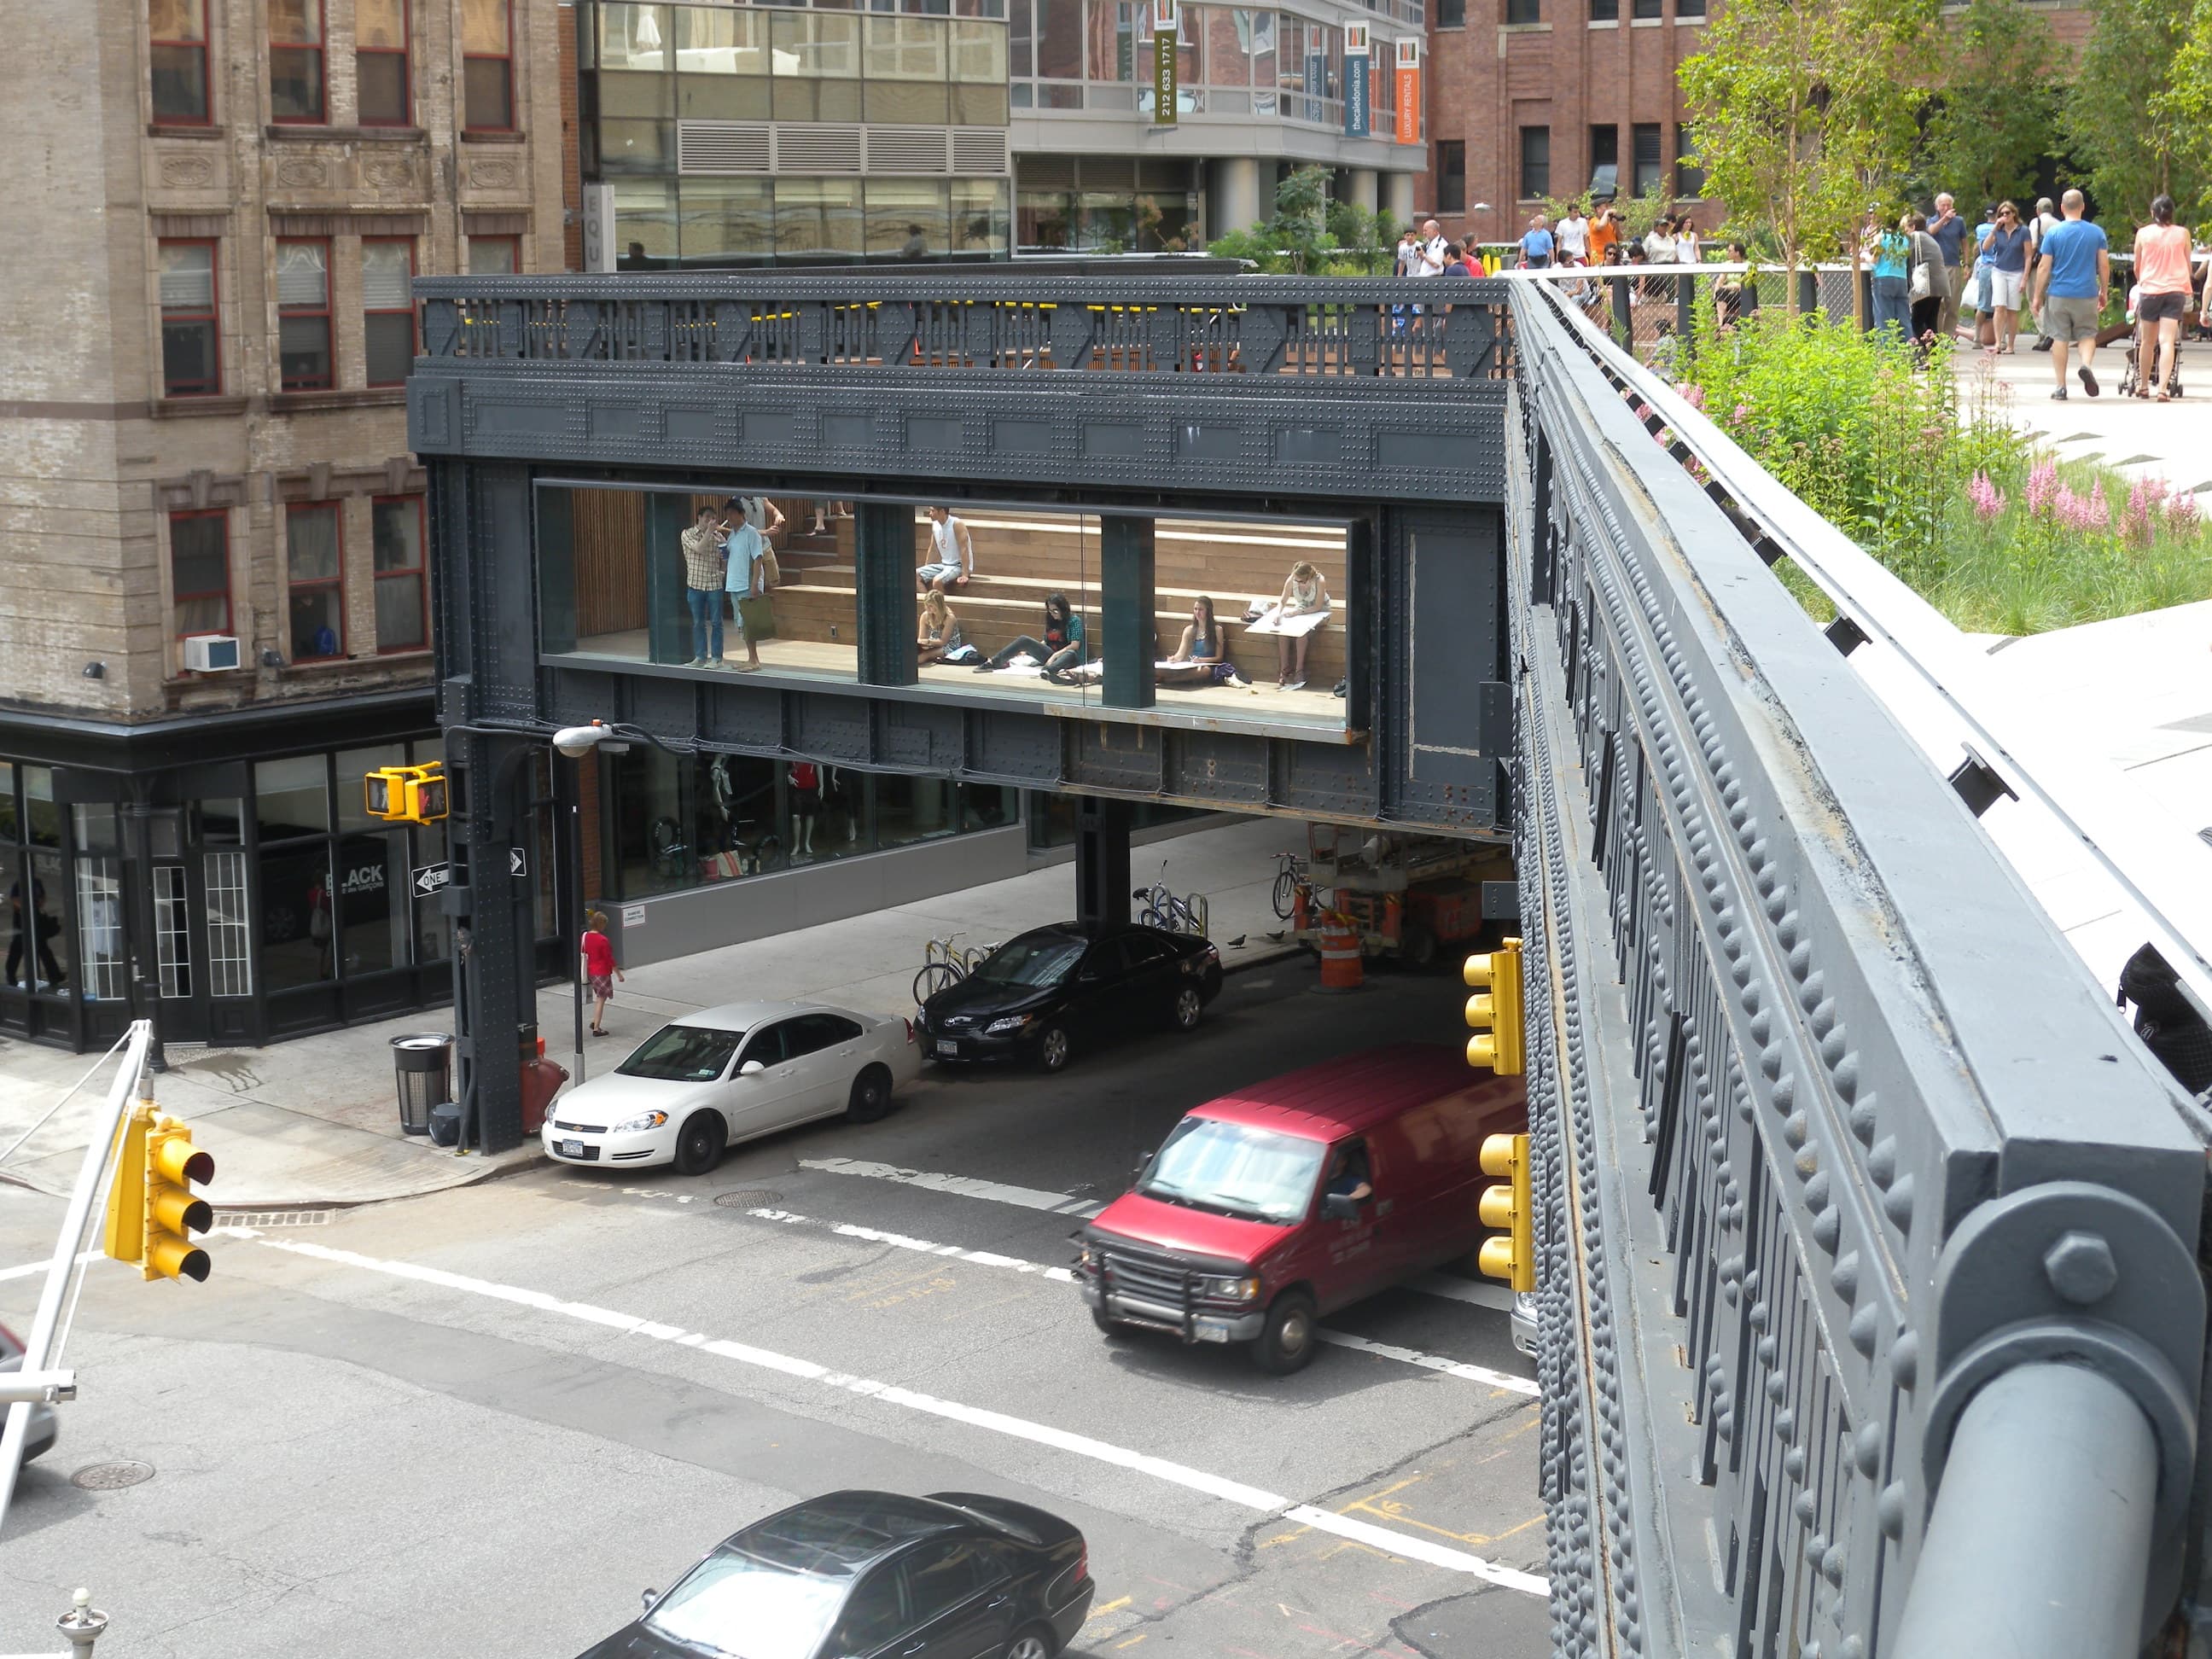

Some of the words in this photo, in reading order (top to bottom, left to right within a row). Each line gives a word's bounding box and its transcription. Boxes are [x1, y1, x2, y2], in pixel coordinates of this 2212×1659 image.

[1162, 38, 1171, 66] 1717
[1162, 69, 1171, 91] 633
[1404, 73, 1412, 107] RENTALS
[1162, 95, 1171, 116] 212
[1351, 61, 1360, 131] thecaledonia.com
[1404, 108, 1412, 137] LUXURY
[423, 872, 442, 886] ONE
